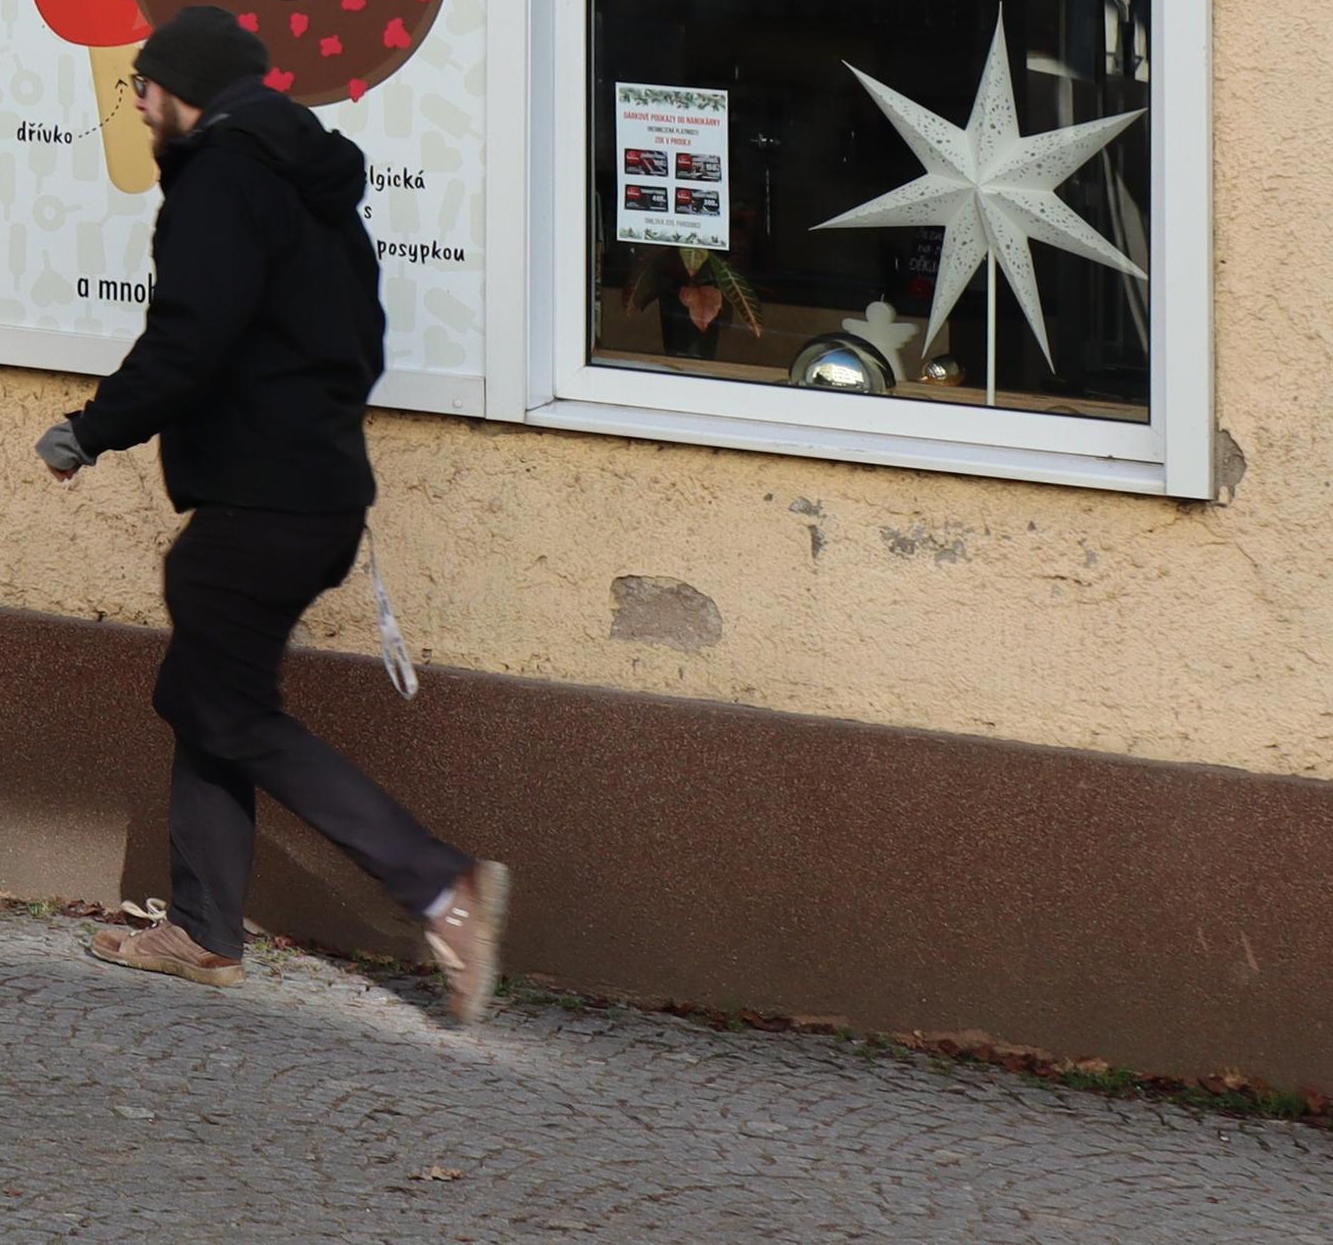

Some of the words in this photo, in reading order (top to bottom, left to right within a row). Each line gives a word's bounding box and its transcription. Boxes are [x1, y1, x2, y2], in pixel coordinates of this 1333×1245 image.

[16, 120, 73, 144] dřívko
[365, 165, 425, 192] lgická
[364, 205, 372, 219] s
[376, 239, 466, 262] posypkou
[77, 276, 89, 299] a
